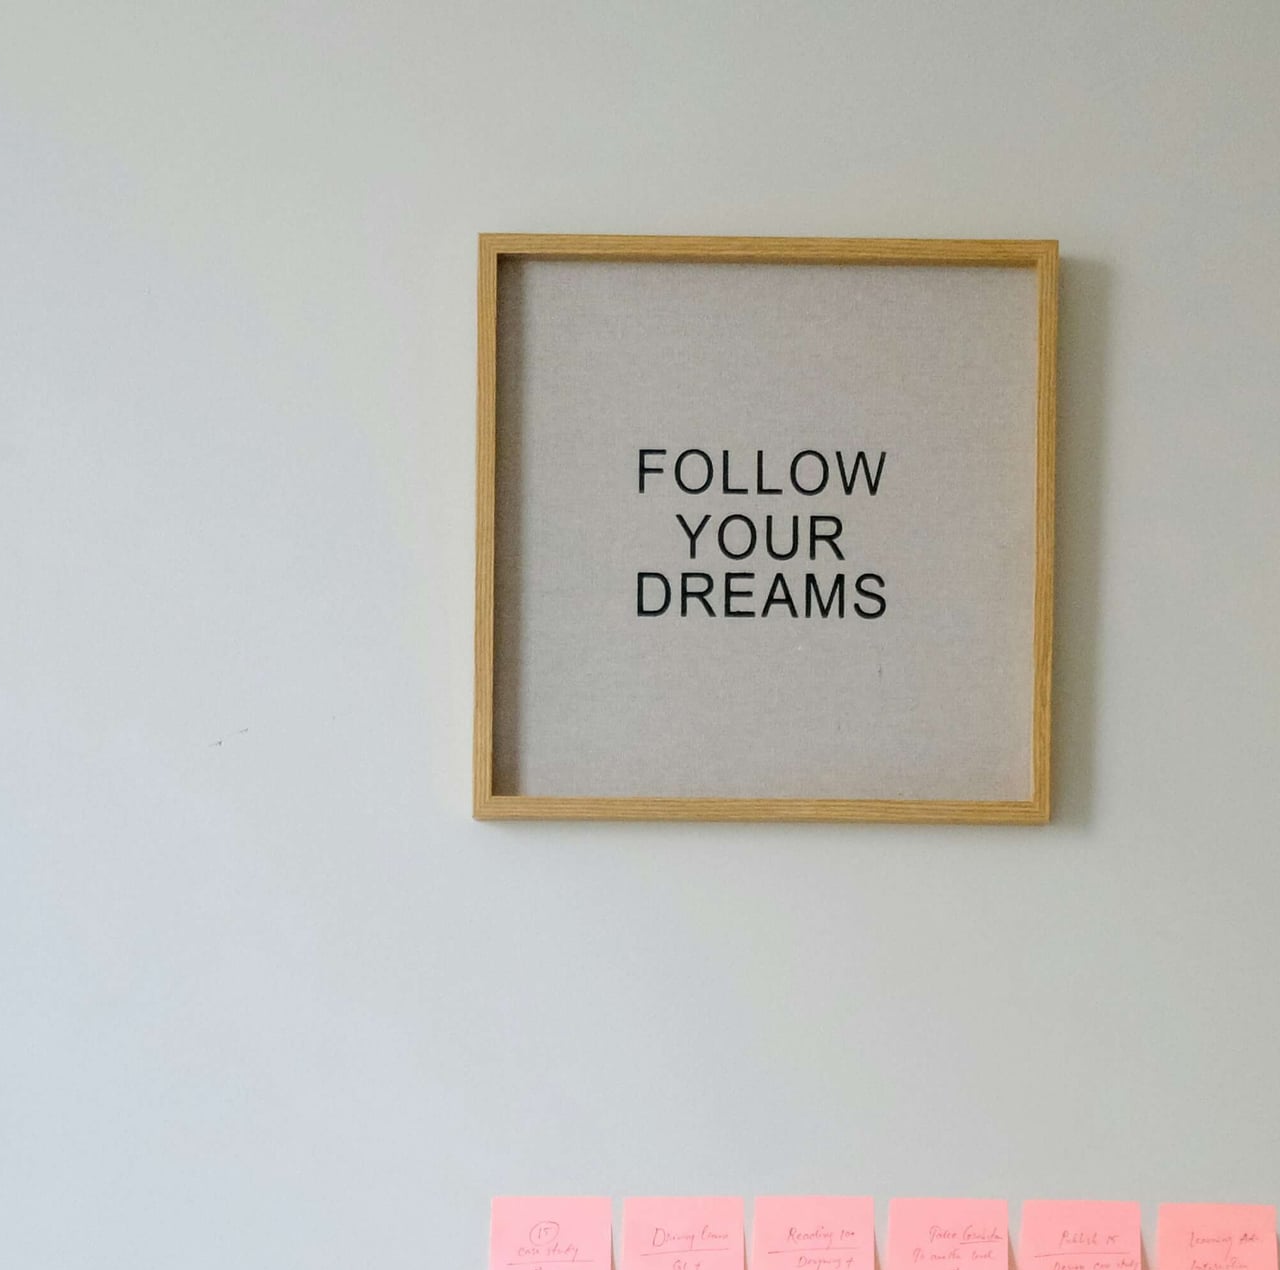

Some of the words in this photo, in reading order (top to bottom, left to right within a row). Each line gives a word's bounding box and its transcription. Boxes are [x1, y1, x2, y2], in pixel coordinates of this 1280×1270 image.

[637, 448, 887, 496] FOLLOW
[675, 513, 846, 561] YOUR
[636, 571, 887, 620] DREAMS
